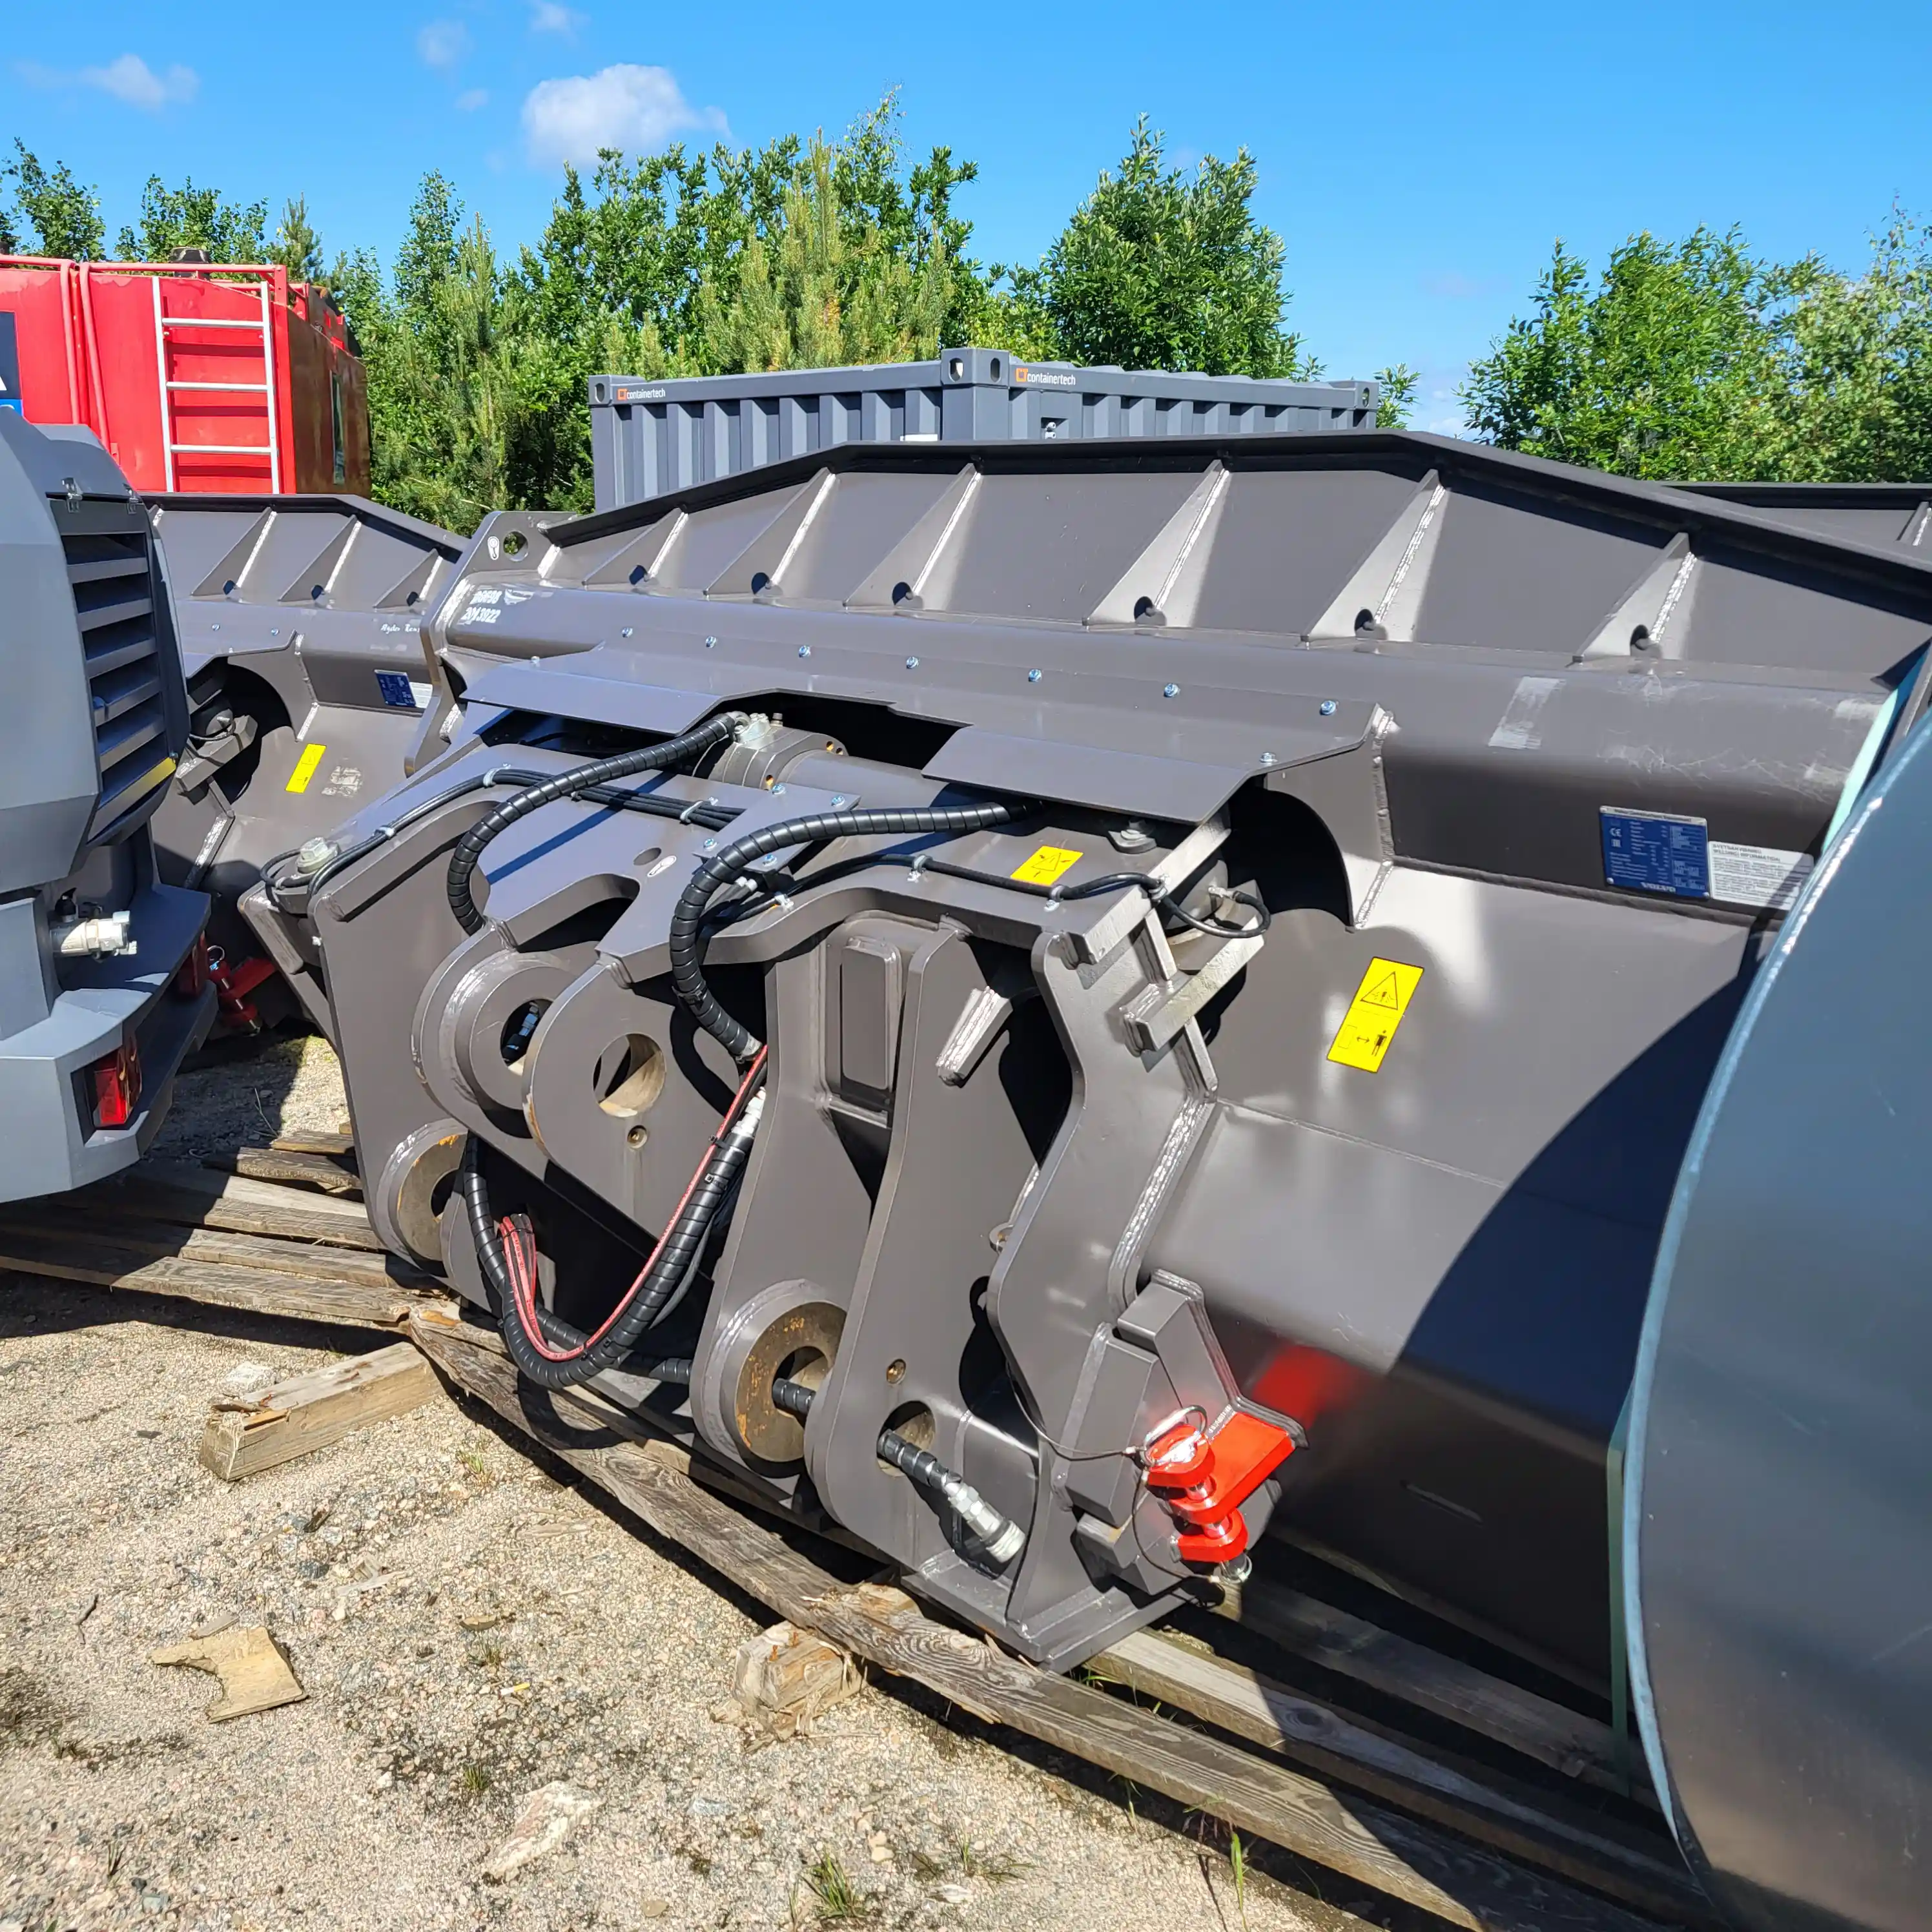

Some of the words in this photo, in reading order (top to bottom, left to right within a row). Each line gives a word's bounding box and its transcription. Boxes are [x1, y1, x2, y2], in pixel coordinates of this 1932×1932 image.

[1027, 373, 1076, 386] containertech
[626, 387, 666, 399] containertech
[1640, 881, 1676, 894] VOLVO
